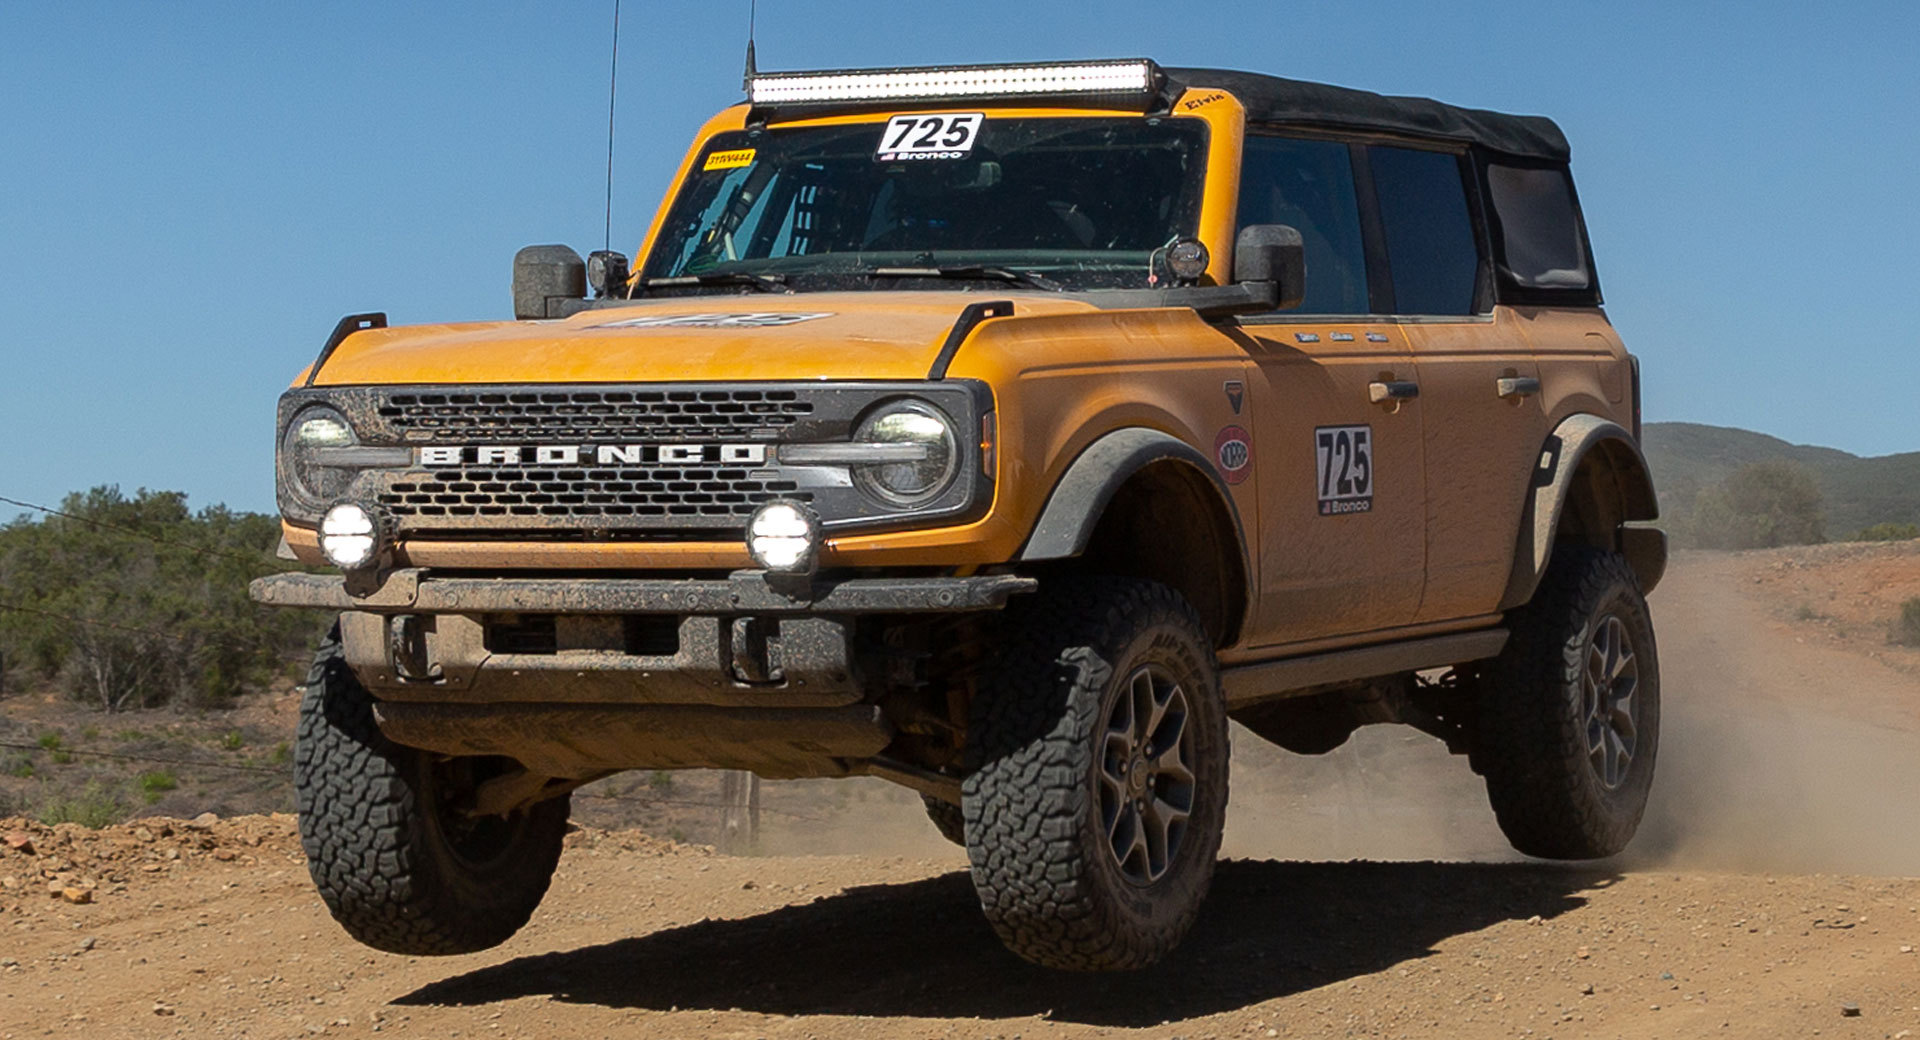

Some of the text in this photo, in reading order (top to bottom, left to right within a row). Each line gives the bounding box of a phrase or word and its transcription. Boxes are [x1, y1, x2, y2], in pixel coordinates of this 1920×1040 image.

[889, 117, 973, 149] 725
[897, 151, 963, 160] Bronco
[420, 445, 766, 465] BRONCO
[1318, 430, 1370, 496] 725
[1332, 500, 1370, 513] Bronco
